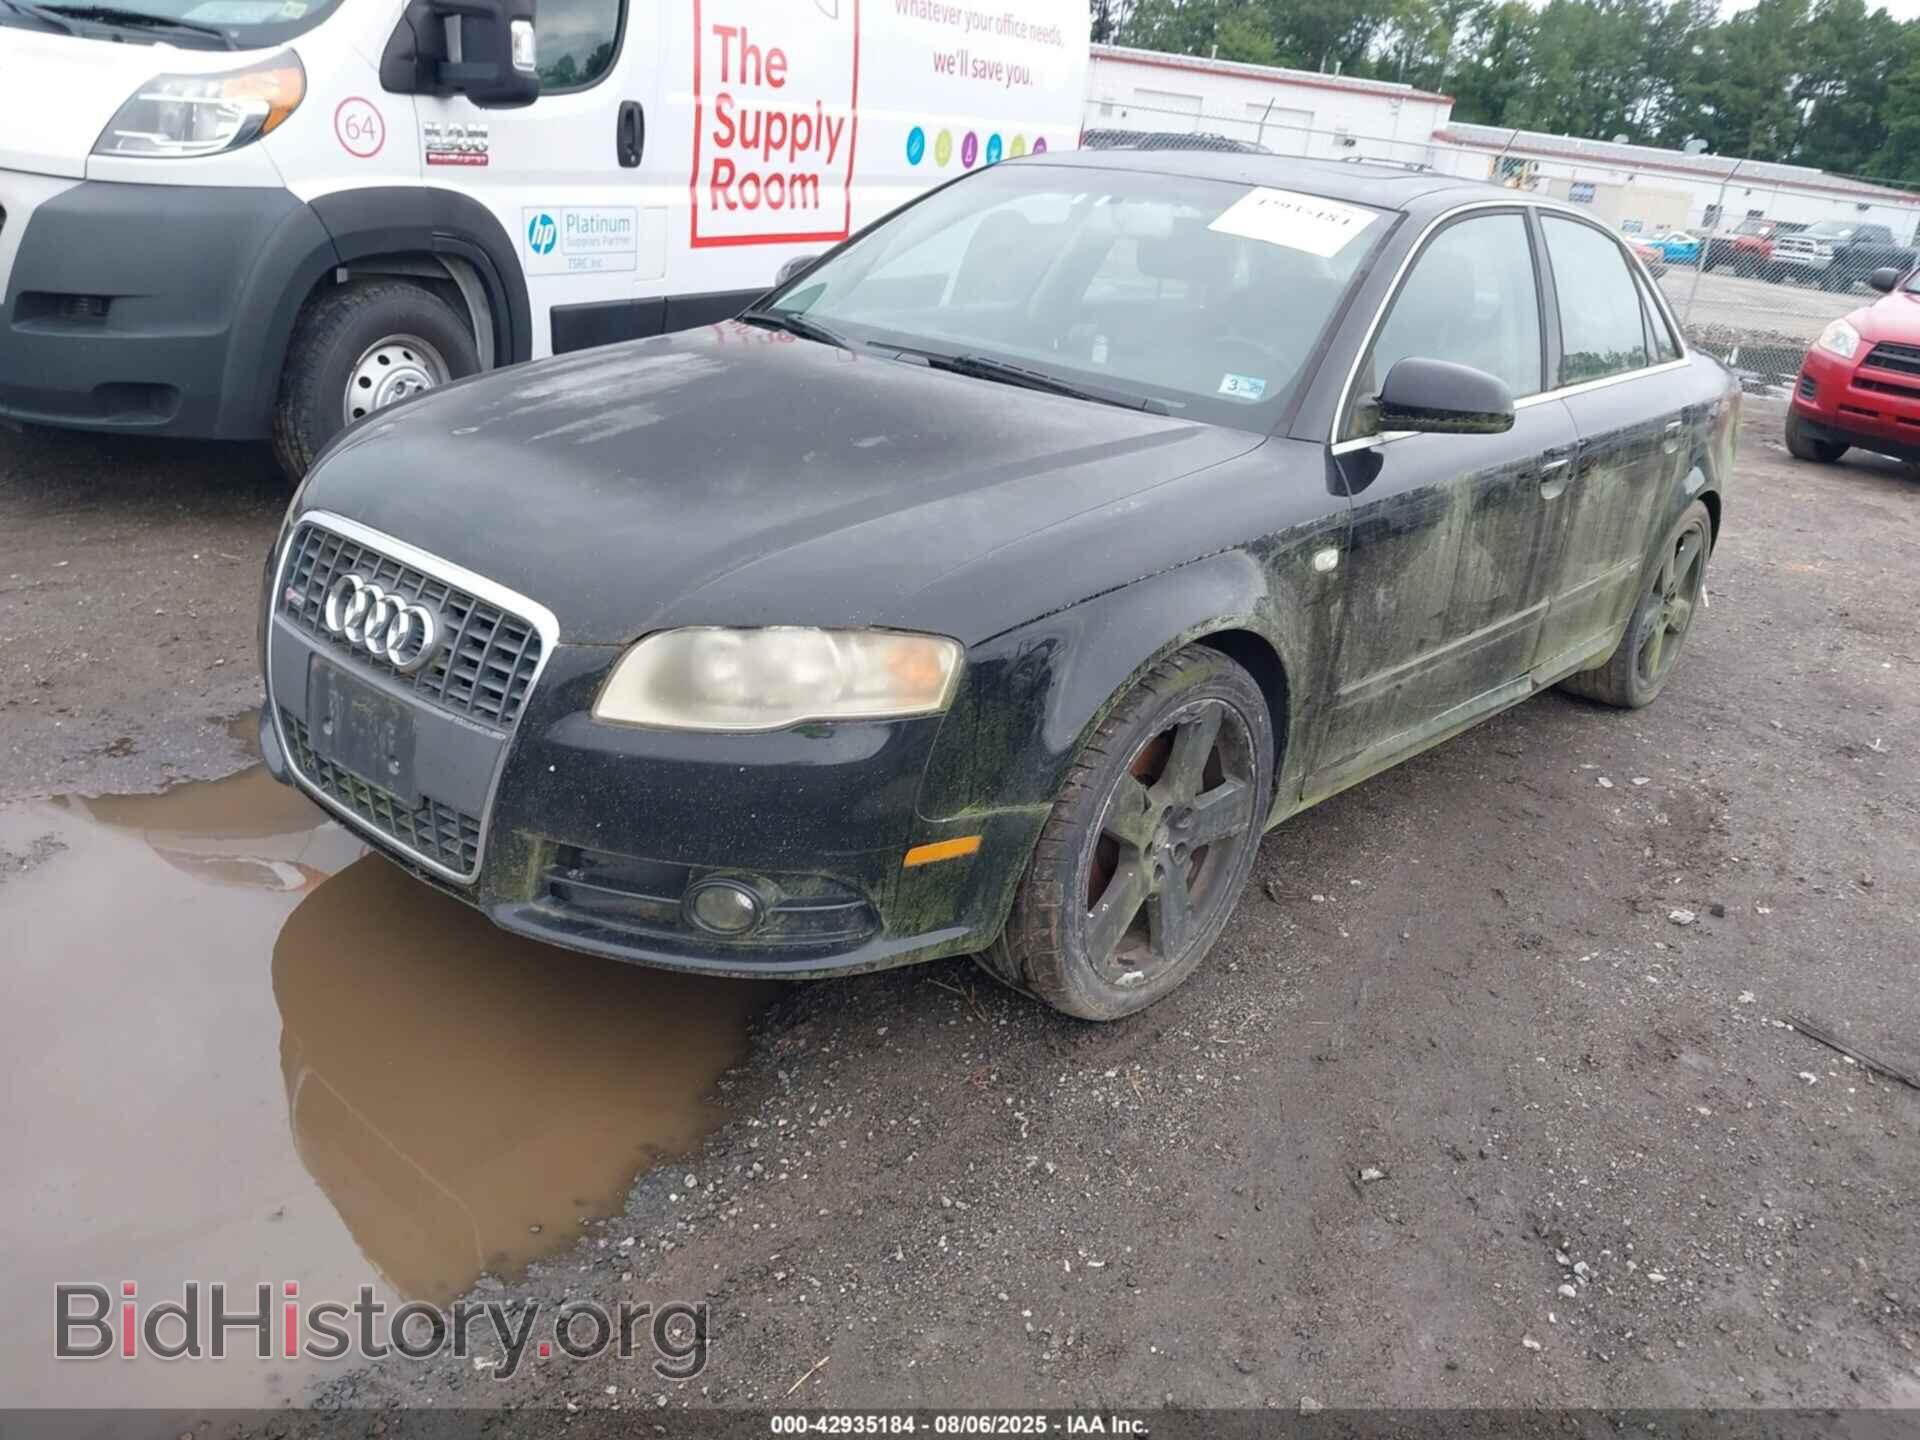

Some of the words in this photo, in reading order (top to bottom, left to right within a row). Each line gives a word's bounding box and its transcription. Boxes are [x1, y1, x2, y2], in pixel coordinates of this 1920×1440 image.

[895, 0, 962, 25] Whatever
[965, 10, 994, 34] your
[995, 13, 1028, 39] office
[1029, 22, 1065, 48] needs,
[712, 24, 788, 88] The
[933, 49, 968, 75] we'll
[971, 57, 1003, 82] save
[1005, 63, 1033, 89] you.
[345, 113, 377, 141] 64
[712, 92, 845, 165] Supply
[710, 158, 820, 211] Room
[529, 213, 557, 255] hp
[566, 213, 631, 234] Platinum
[1227, 379, 1238, 391] 3
